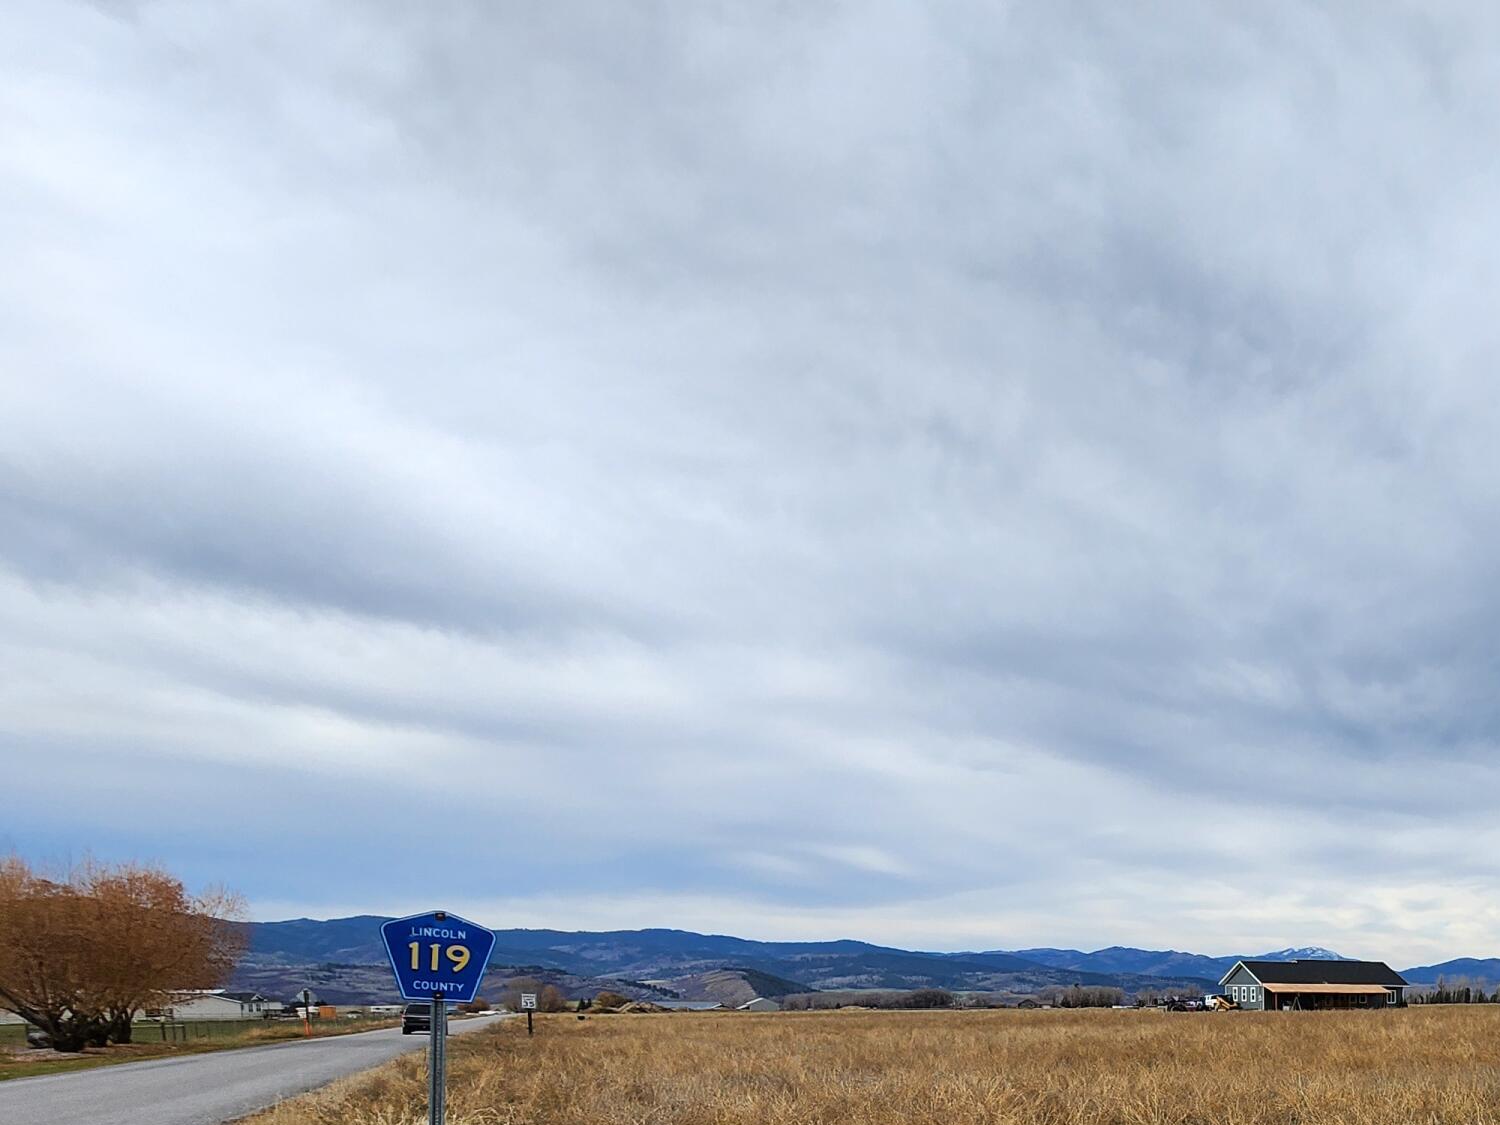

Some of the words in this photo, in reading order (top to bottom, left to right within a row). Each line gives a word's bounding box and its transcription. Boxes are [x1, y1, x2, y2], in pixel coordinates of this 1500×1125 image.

[411, 927, 467, 940] LINCOLN
[408, 941, 471, 973] 119
[413, 980, 465, 992] COUNTY
